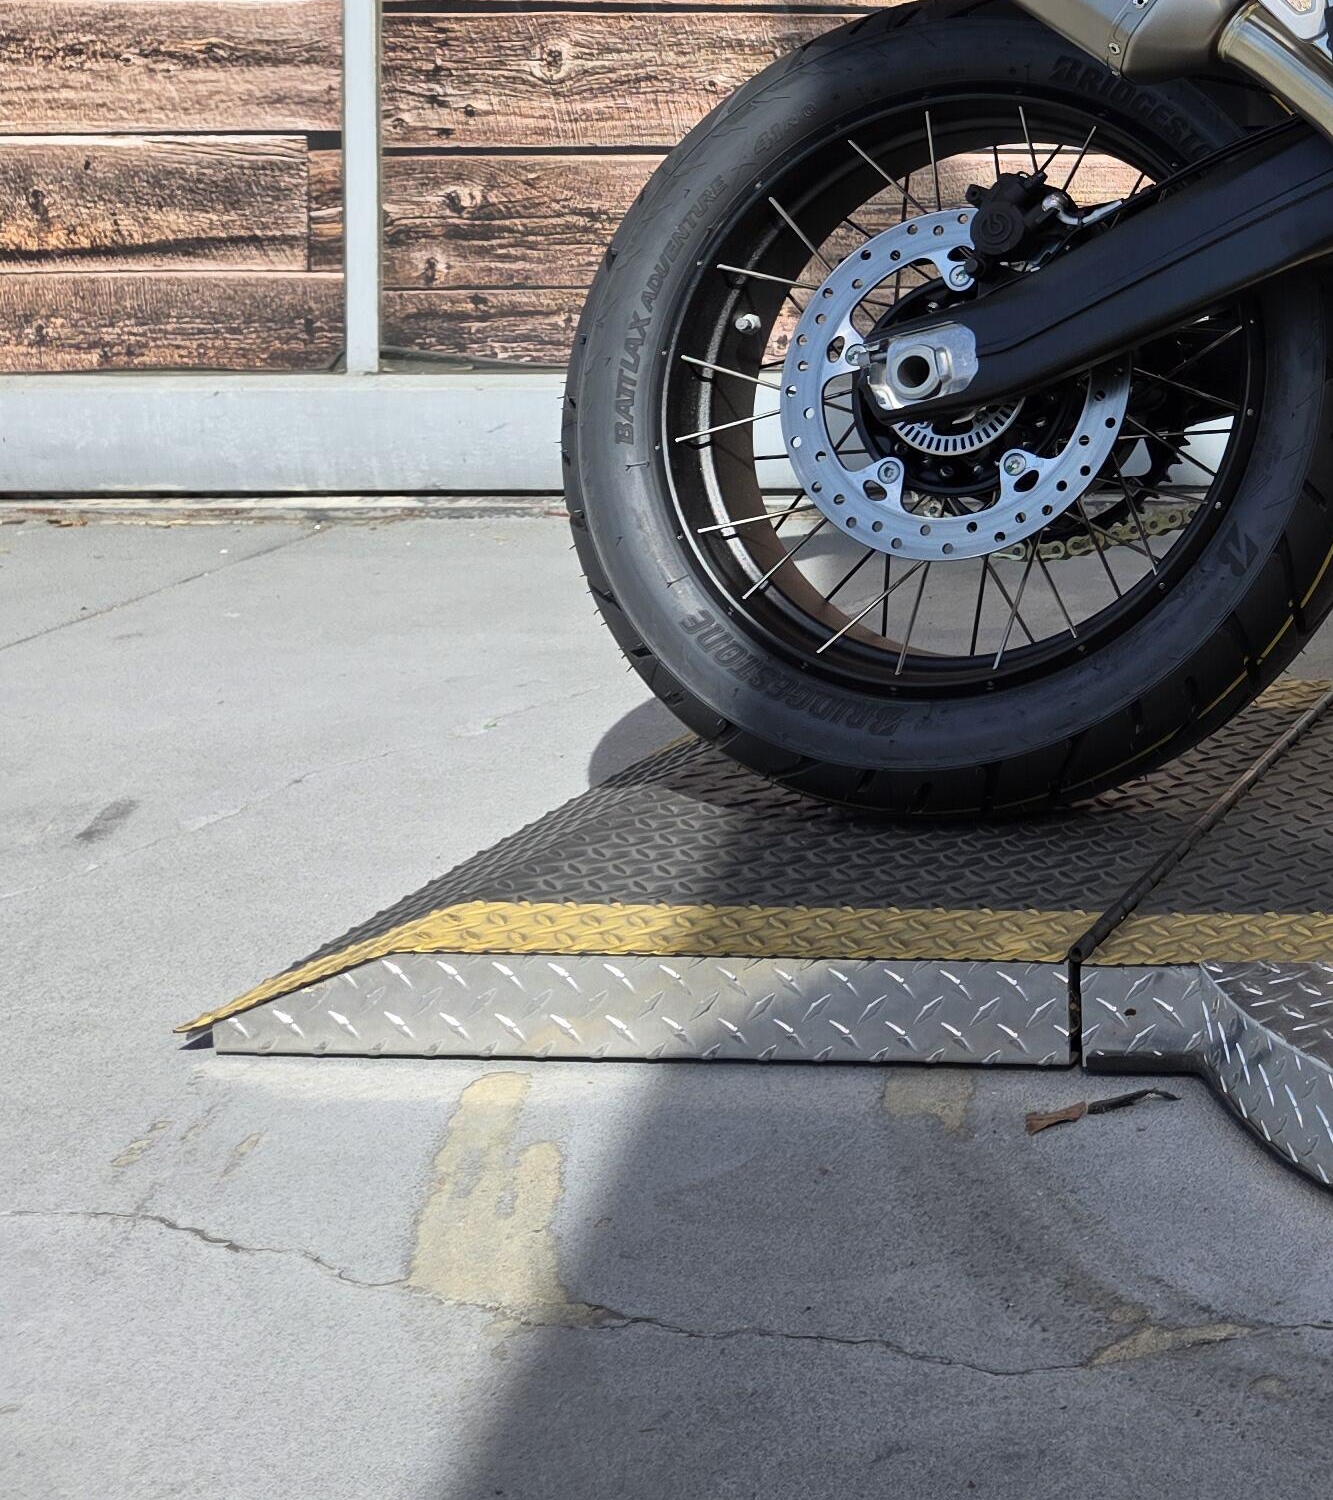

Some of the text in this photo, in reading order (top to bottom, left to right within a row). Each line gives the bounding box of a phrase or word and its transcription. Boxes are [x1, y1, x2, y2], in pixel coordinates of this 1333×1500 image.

[614, 310, 650, 446] BATTLAX
[641, 175, 729, 313] ADVENTURE
[679, 609, 909, 737] BRIDGESTONE
